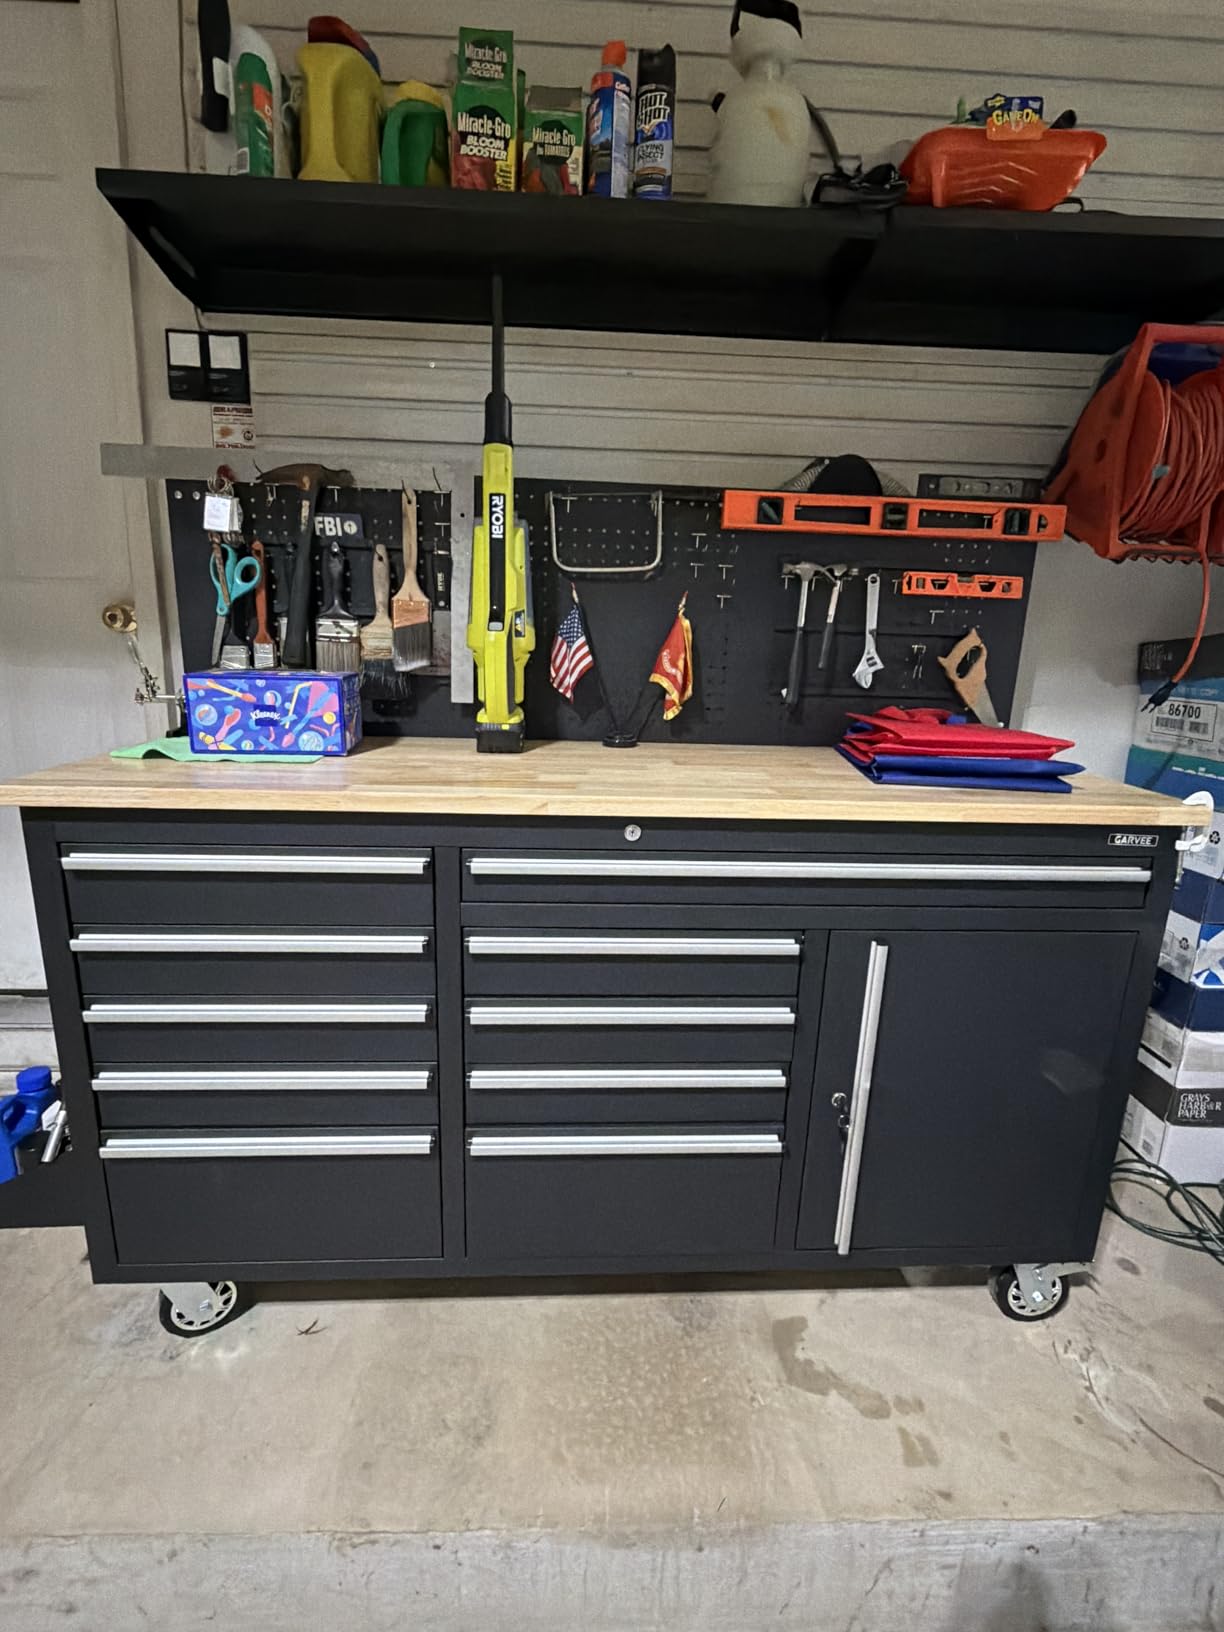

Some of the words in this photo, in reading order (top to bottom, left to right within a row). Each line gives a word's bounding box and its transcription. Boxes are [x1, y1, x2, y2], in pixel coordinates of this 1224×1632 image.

[639, 91, 668, 115] HOT
[457, 111, 511, 139] Miracle-Gro
[636, 104, 670, 130] SHOT
[466, 134, 505, 150] BLOOM
[460, 144, 507, 160] BOOSTER
[491, 495, 504, 539] RYOBI
[314, 516, 343, 537] FBI
[1168, 703, 1201, 719] 86700
[1114, 835, 1153, 845] GARVEE
[1180, 1092, 1211, 1103] GRAYS
[1177, 1109, 1207, 1119] PAPER
